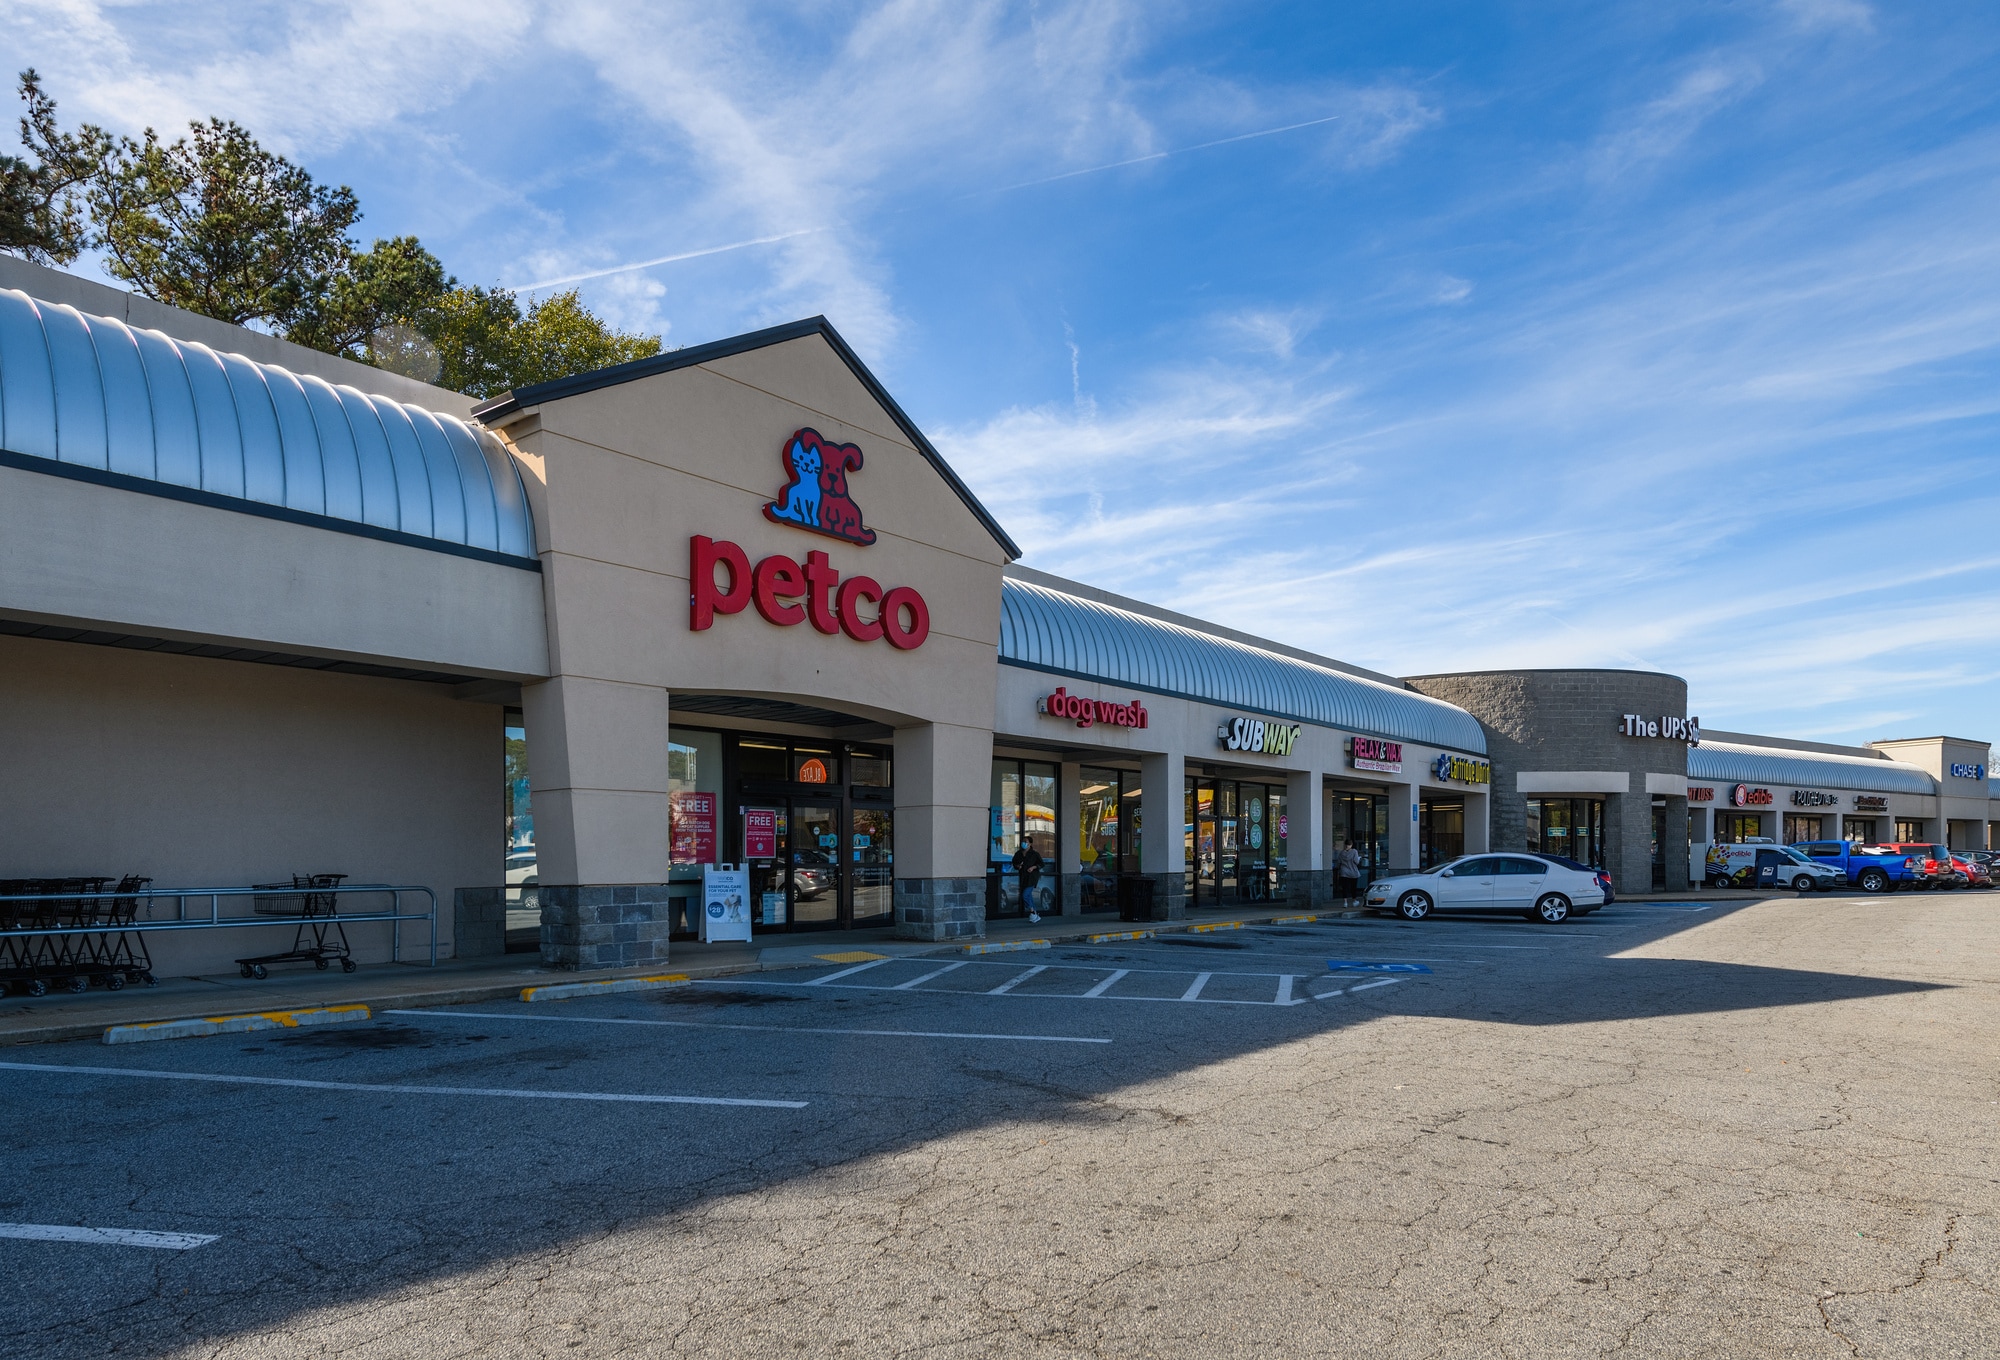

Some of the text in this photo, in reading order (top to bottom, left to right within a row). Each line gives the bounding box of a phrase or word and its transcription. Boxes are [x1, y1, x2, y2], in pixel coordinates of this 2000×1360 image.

[690, 534, 930, 650] petco
[1047, 687, 1148, 729] dog wash
[1623, 714, 1658, 738] The
[1662, 716, 1687, 740] UPS
[1228, 717, 1301, 756] SUBWAY
[1354, 737, 1402, 762] RELAX & WAX
[1356, 759, 1400, 772] Authentic Brazilian Wax
[1450, 755, 1490, 785] Cartridge World
[1953, 763, 1977, 779] CHASE
[1697, 788, 1714, 801] LOSS
[1748, 789, 1773, 805] edible
[678, 799, 709, 813] FREE
[749, 816, 772, 826] FREE
[1101, 826, 1116, 836] SUBS
